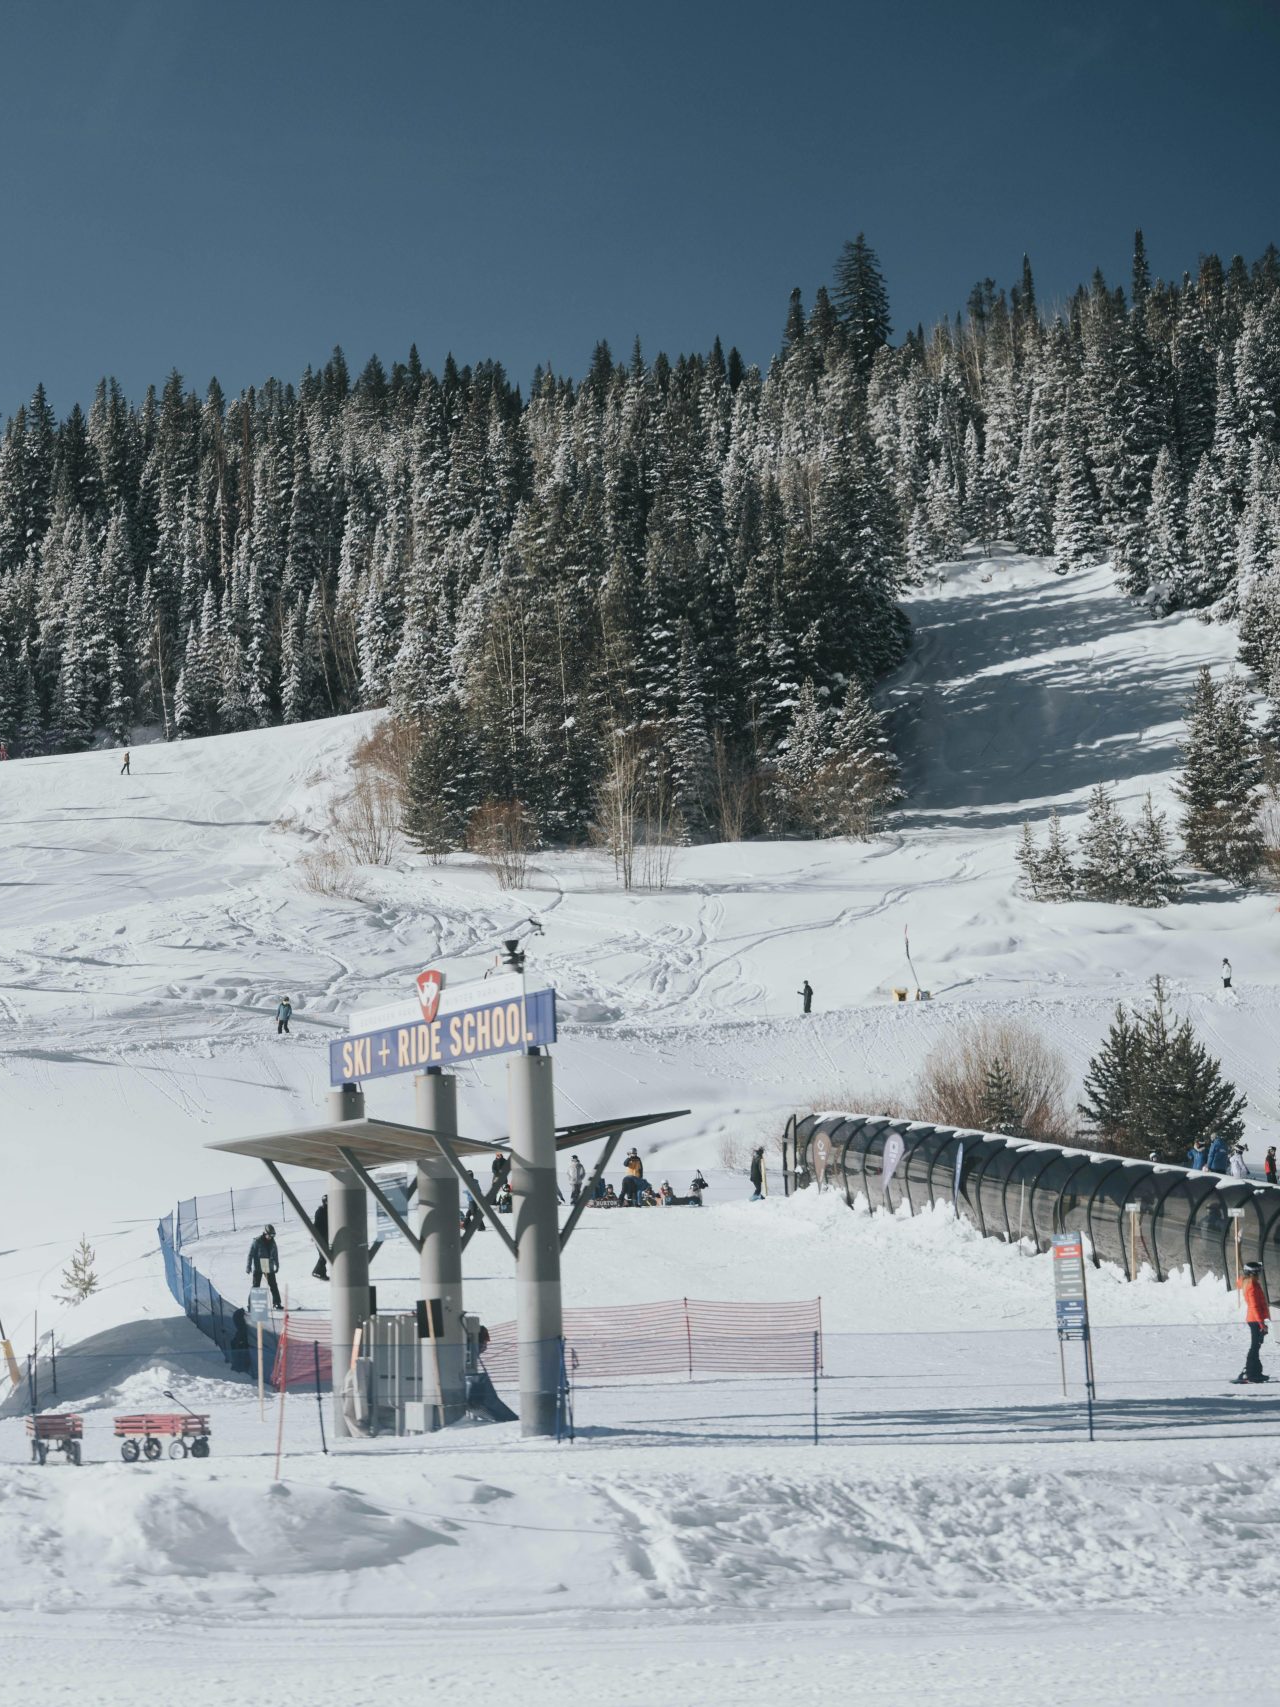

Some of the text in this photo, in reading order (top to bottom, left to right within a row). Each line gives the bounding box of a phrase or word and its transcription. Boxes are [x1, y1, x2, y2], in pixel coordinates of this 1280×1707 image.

[343, 1001, 533, 1078] SKI + RIDE SCHOOL
